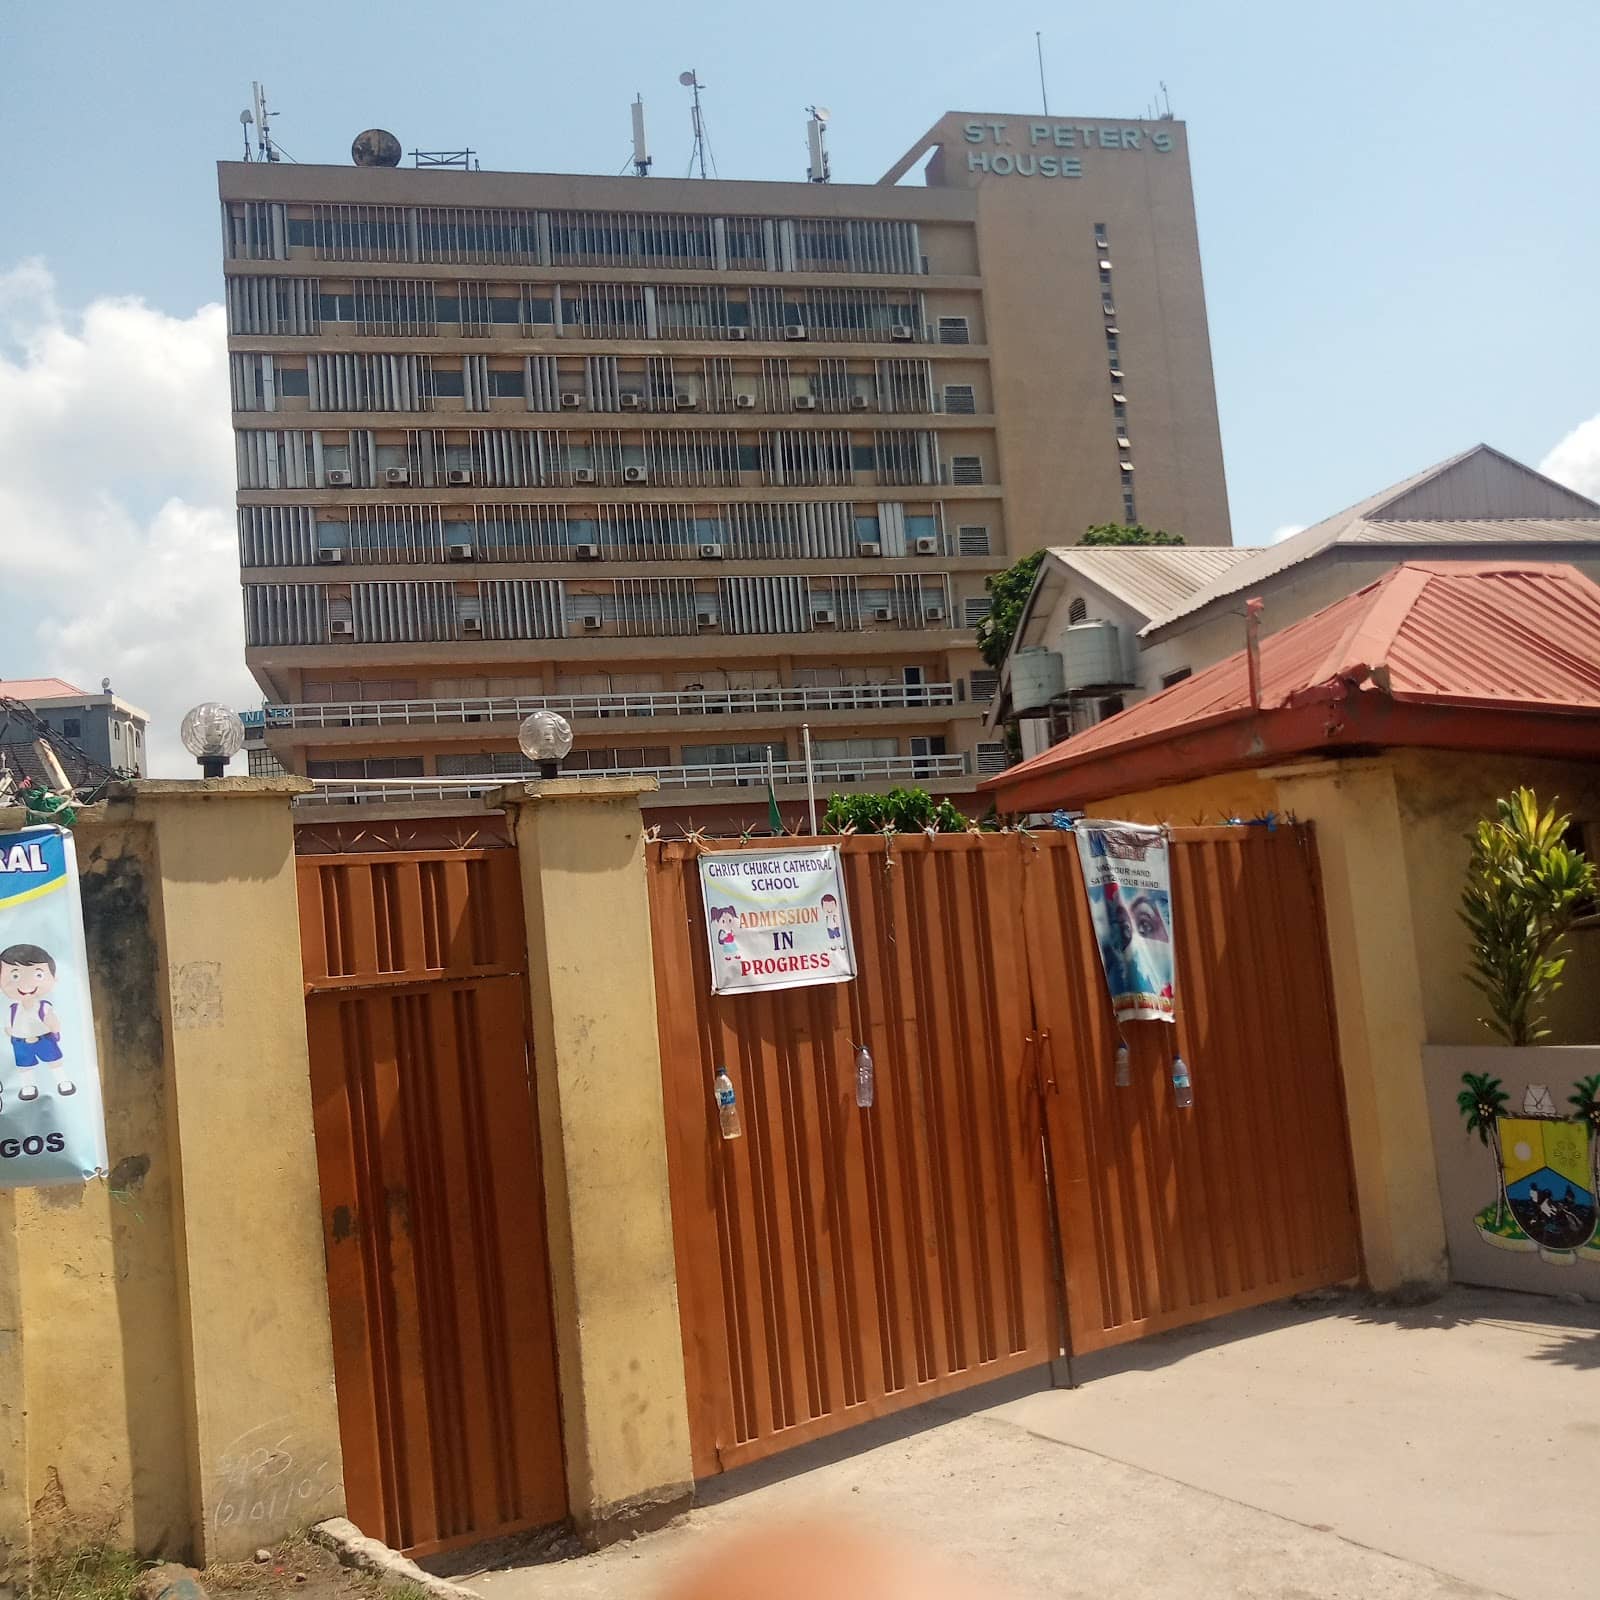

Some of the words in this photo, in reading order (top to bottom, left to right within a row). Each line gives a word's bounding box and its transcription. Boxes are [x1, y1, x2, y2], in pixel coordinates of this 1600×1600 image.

[964, 120, 1012, 146] ST.
[1030, 122, 1174, 152] PETER'S
[968, 151, 1083, 177] HOUSE
[709, 863, 741, 877] CHRIST
[743, 861, 781, 876] CHURCH
[783, 858, 832, 873] CATHEDRAL
[751, 877, 799, 891] SCHOOL
[739, 906, 819, 929] ADMISSION
[773, 931, 794, 951] IN
[741, 953, 831, 976] PROGRESS
